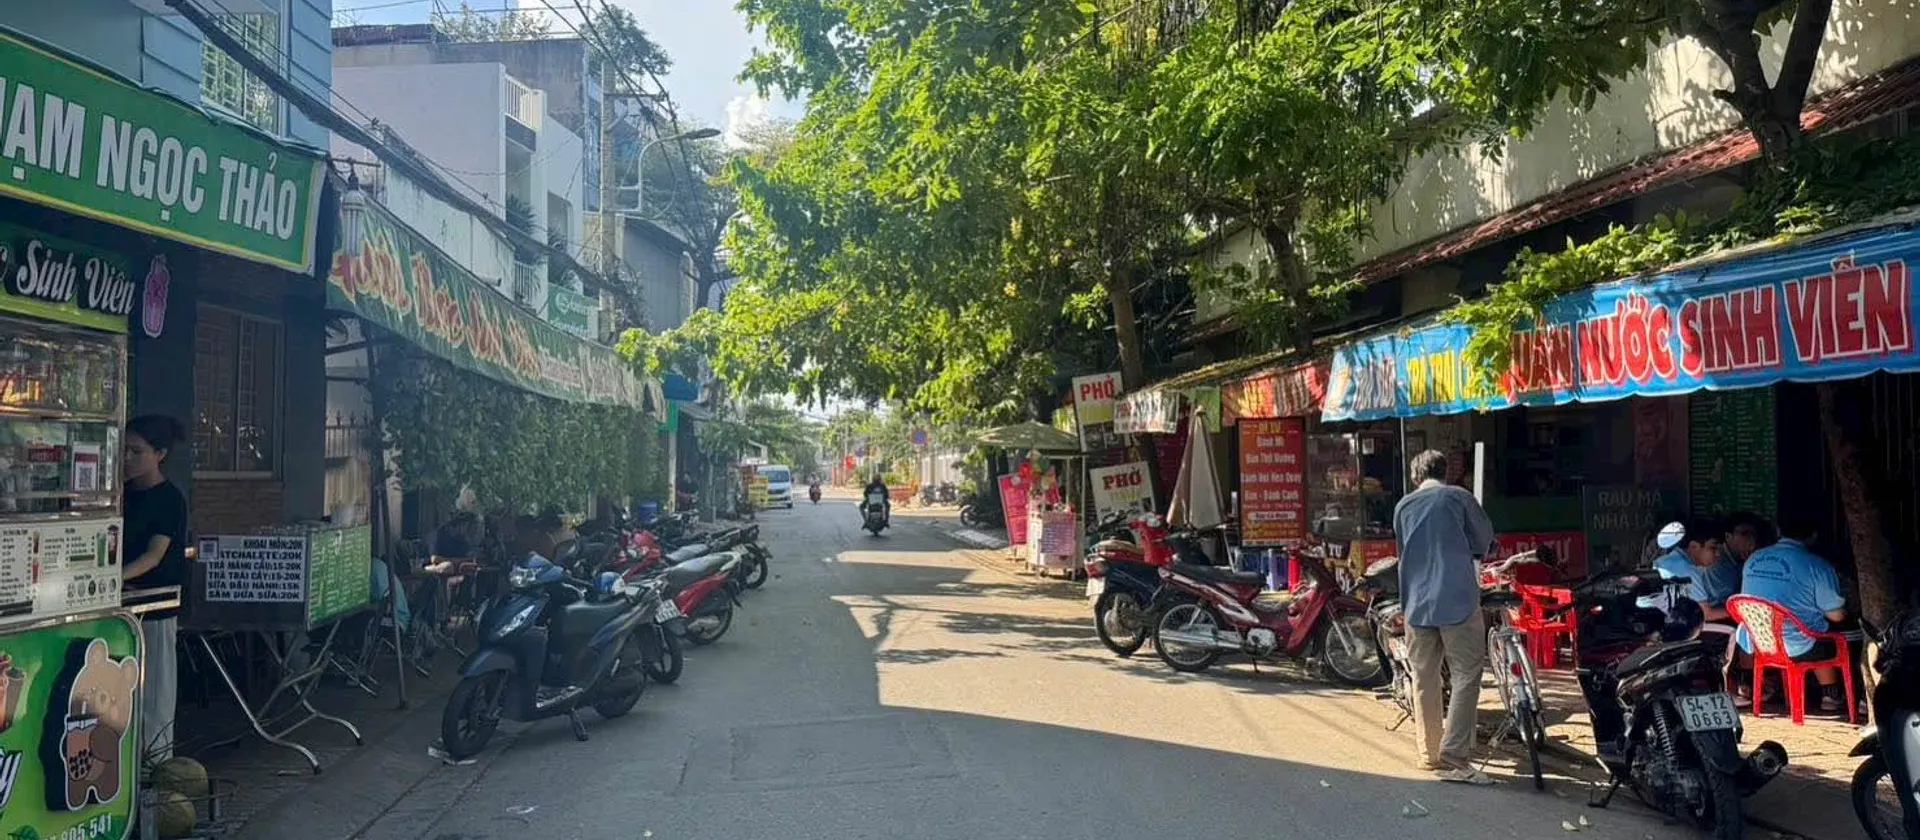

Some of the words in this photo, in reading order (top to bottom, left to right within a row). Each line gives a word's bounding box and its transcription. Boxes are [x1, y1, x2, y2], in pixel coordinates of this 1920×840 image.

[0, 77, 86, 181] ẠM
[97, 114, 207, 222] NGỌC
[218, 152, 297, 241] THẢO
[16, 239, 77, 302] Sinh
[84, 257, 136, 316] Viên
[1499, 314, 1573, 402] UÁN
[1577, 288, 1677, 387] NƯỚC
[1678, 283, 1782, 378] SINH
[1783, 249, 1914, 366] VIÊN
[1081, 374, 1115, 401] PHỞ
[1102, 466, 1142, 490] PHỞ
[1692, 711, 1732, 727] 0663
[90, 812, 112, 838] 541
